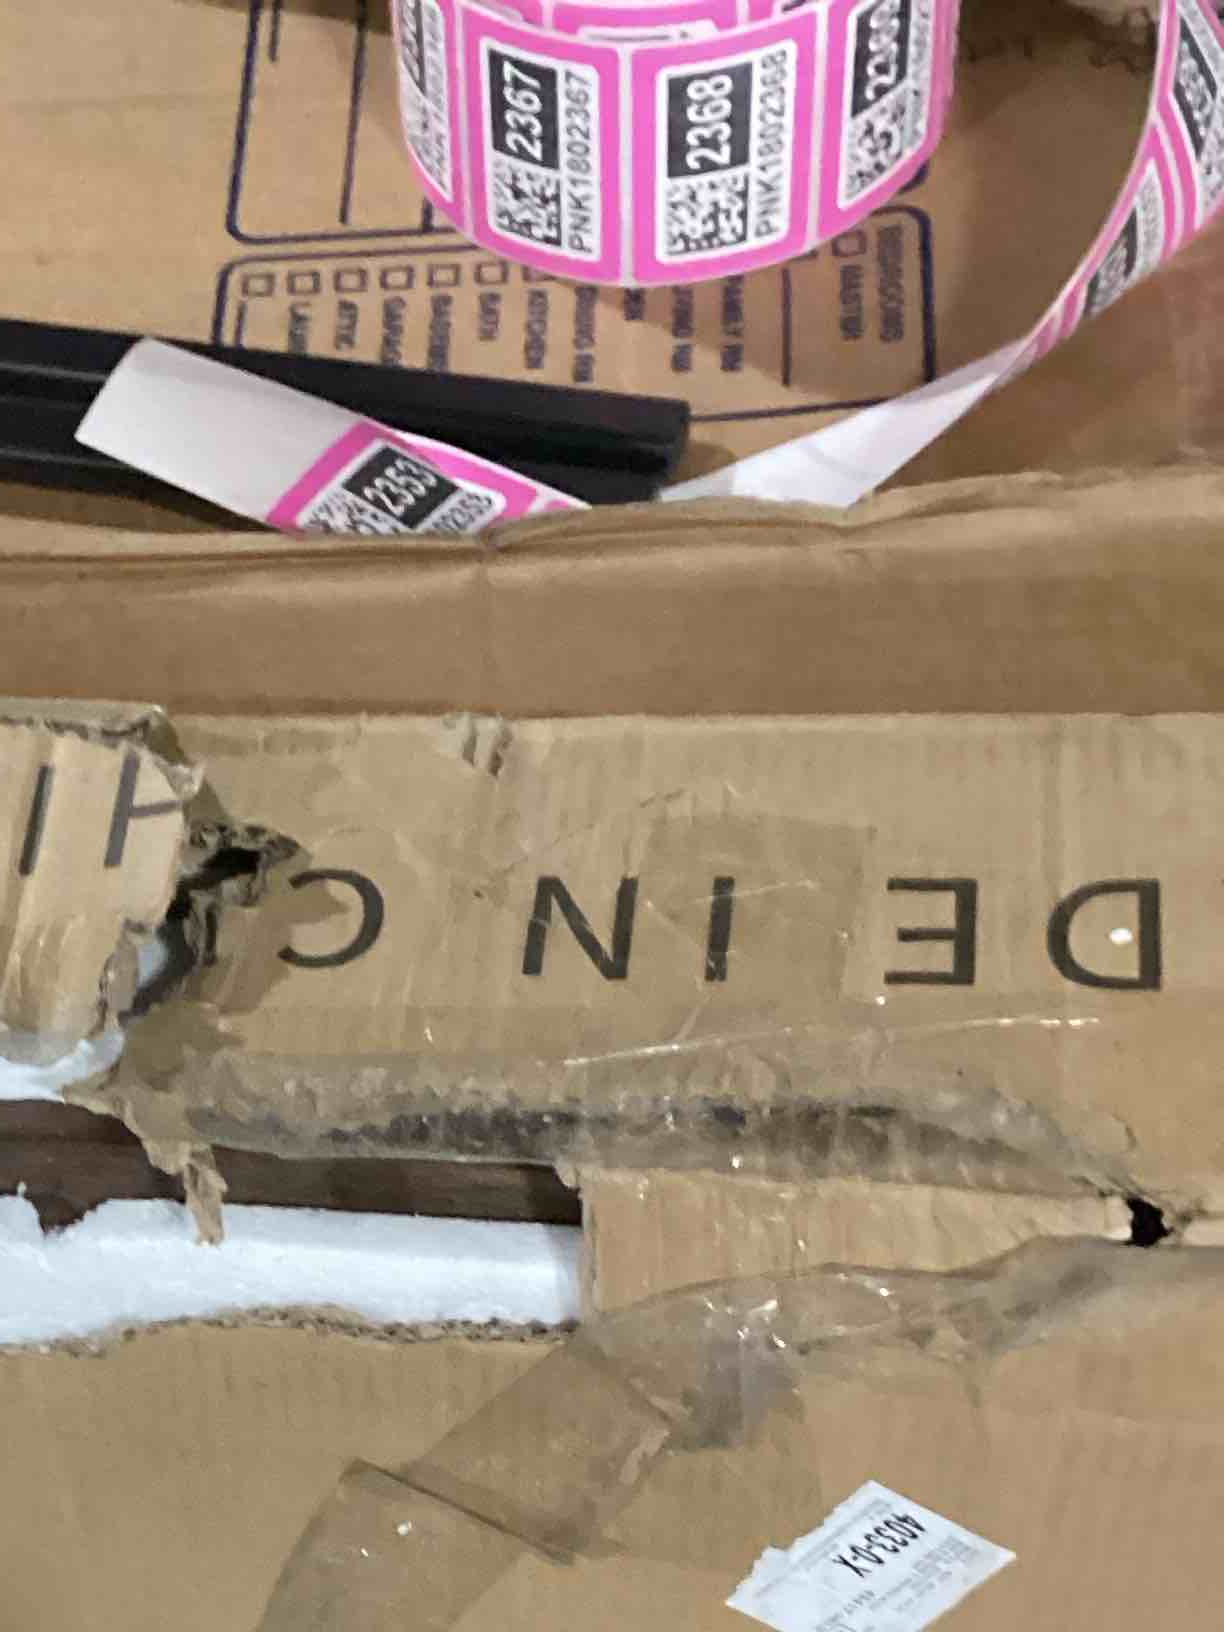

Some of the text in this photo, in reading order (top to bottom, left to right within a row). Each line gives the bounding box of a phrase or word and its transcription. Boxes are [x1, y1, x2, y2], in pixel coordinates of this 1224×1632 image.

[503, 60, 543, 161] 2367
[685, 73, 733, 170] 2368
[754, 48, 788, 239] PNK1802368
[564, 69, 593, 254] PNK1802367
[524, 288, 549, 370] KITCHEN
[363, 457, 437, 516] 2353
[521, 876, 736, 982] IN
